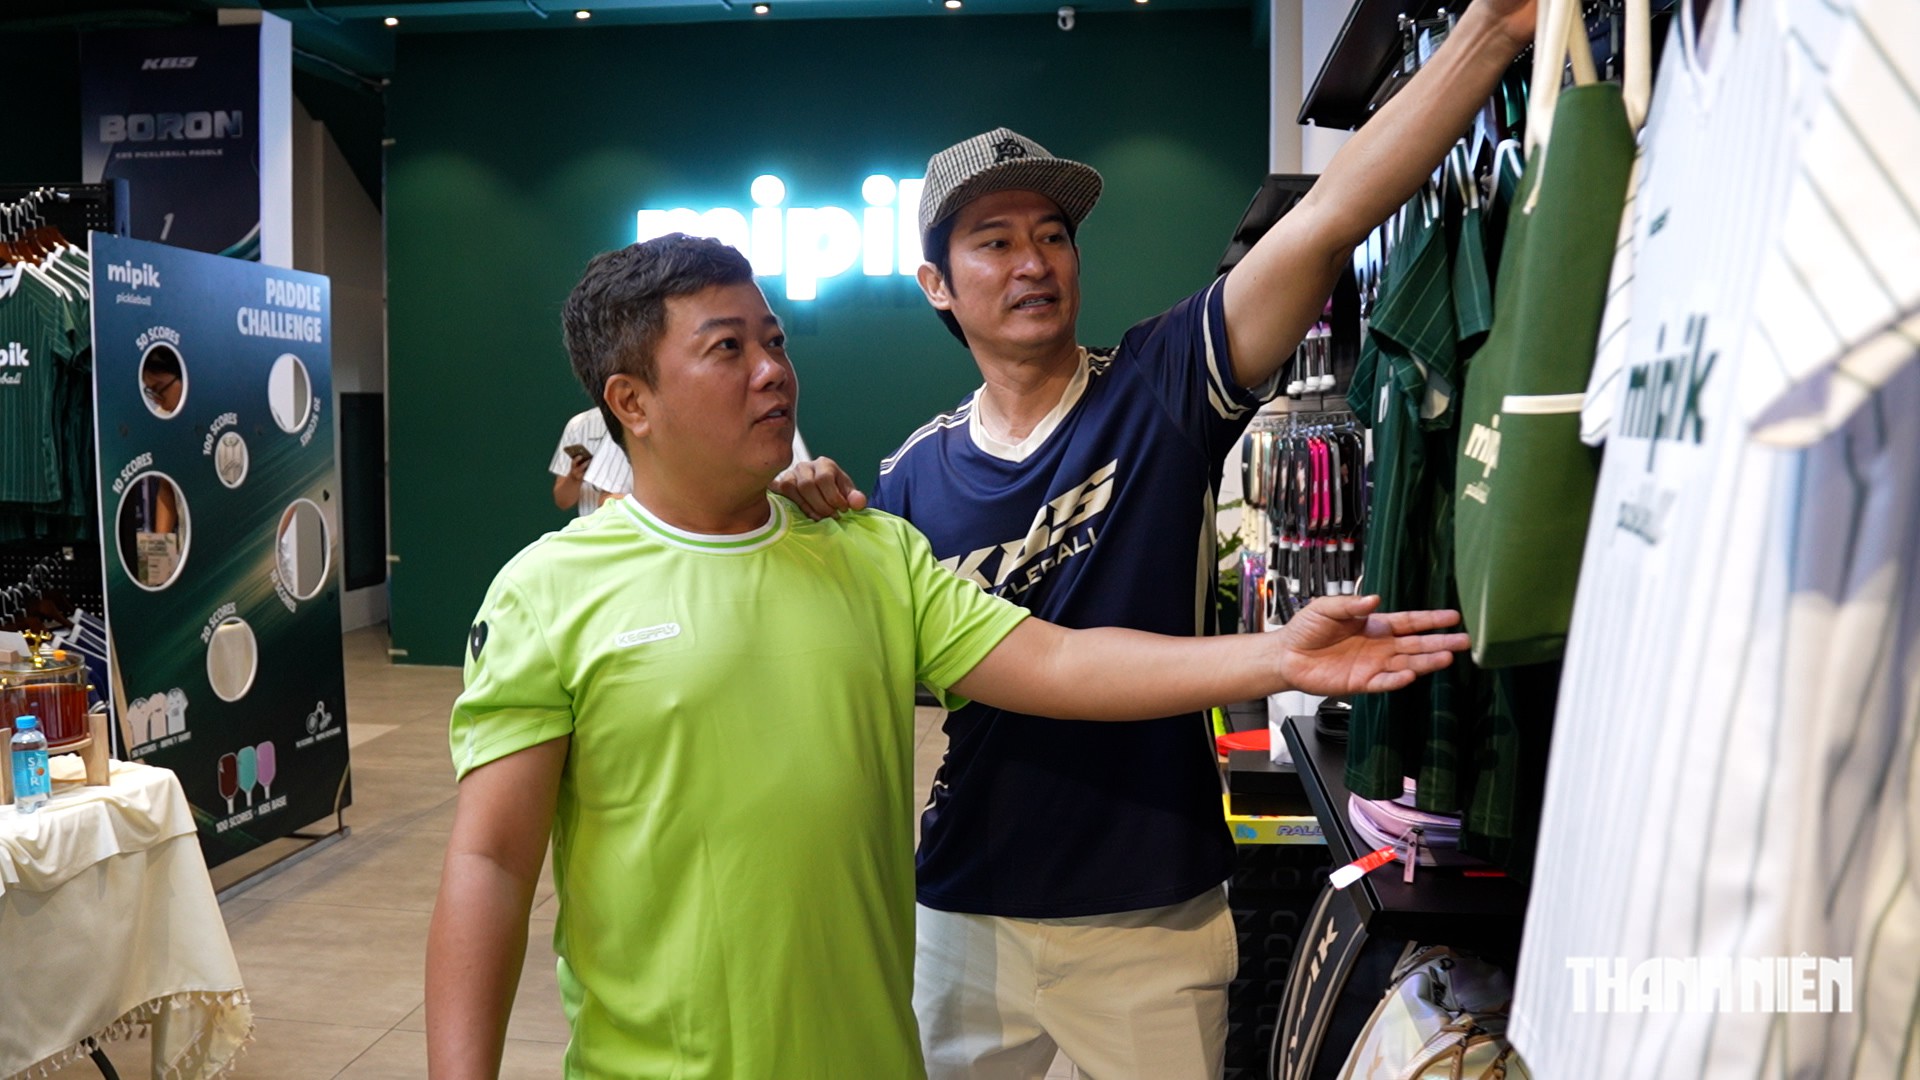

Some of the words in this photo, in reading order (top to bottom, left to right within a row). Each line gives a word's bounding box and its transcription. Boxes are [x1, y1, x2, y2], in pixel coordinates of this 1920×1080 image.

[141, 56, 198, 70] KBS
[100, 110, 243, 143] BORON
[107, 260, 161, 290] mipik
[265, 277, 321, 312] PADDLE
[135, 333, 149, 351] 50
[147, 325, 180, 346] SCORES
[237, 306, 322, 343] CHALLENGE
[203, 433, 214, 455] 100
[210, 412, 237, 436] SCORES
[300, 412, 319, 447] SCORES
[112, 477, 124, 494] 10
[121, 452, 153, 482] SCORES
[200, 625, 211, 644] 20
[209, 602, 236, 629] SCORES
